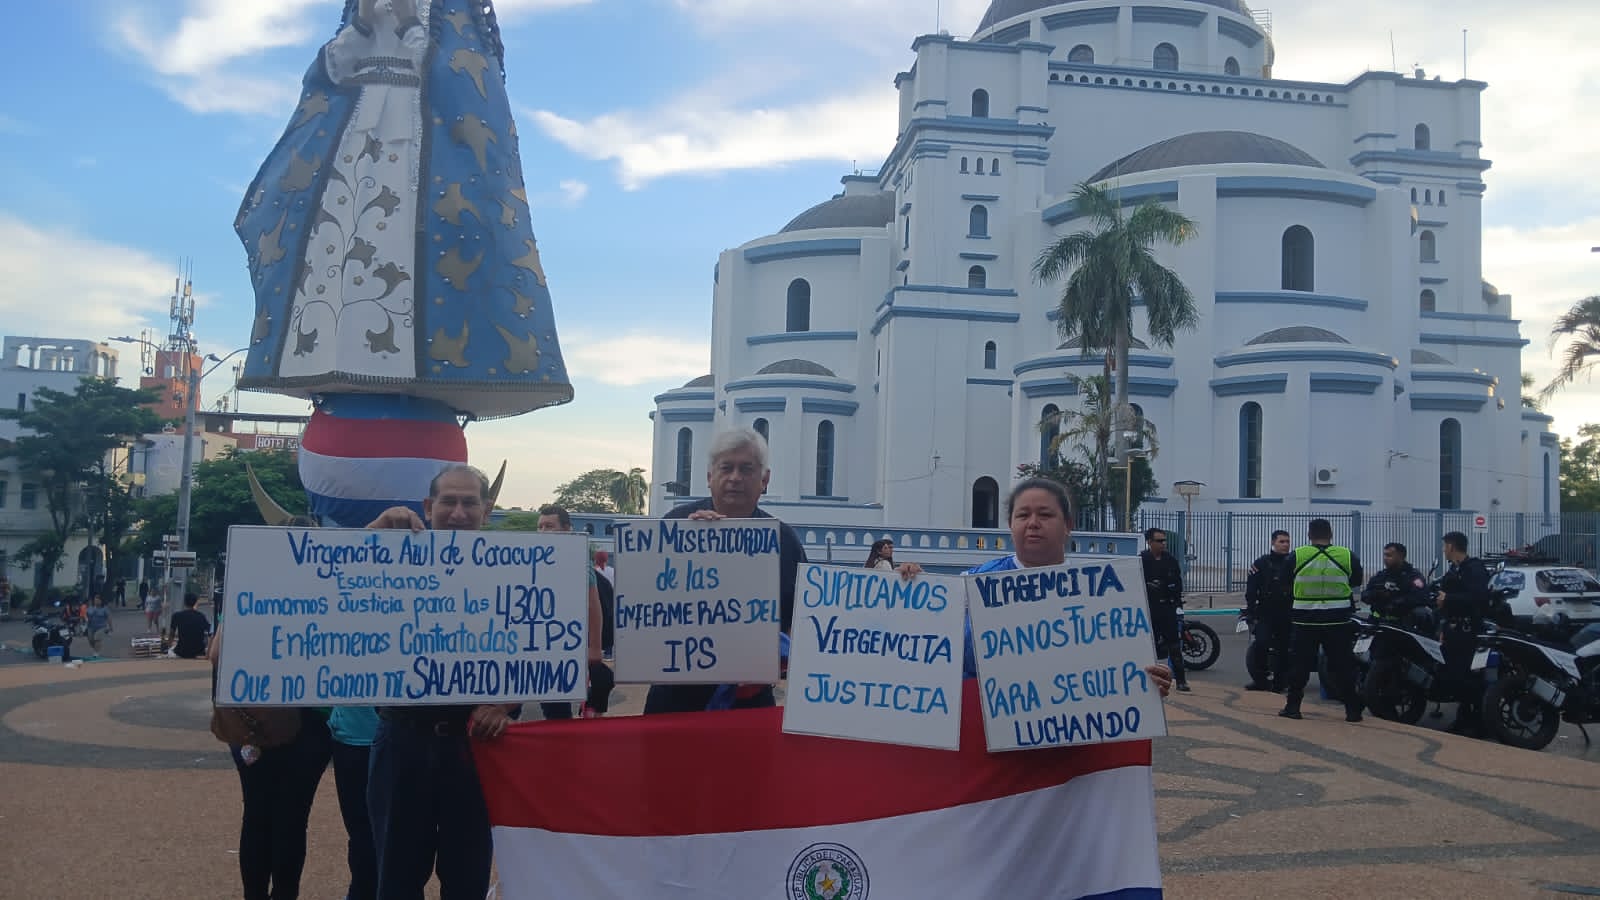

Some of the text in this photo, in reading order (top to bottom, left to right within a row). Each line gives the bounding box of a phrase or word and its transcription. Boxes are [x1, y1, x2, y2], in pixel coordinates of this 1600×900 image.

[287, 531, 393, 579] Virgencita
[398, 531, 435, 567] Azul
[439, 530, 464, 566] de
[613, 520, 781, 557] TEN MISERICORDIA
[656, 557, 720, 592] de las
[975, 563, 1125, 608] VIRGENCITA
[237, 591, 329, 617] Clamamos
[338, 592, 405, 615] Justicia
[413, 596, 457, 630] para
[463, 587, 490, 615] las
[744, 599, 781, 625] DEL
[271, 618, 582, 660] Enfermeras Contratadas IPS
[662, 636, 717, 673] IPS
[809, 615, 952, 664] VIRGENCITA
[980, 619, 1069, 659] DANOS
[281, 673, 306, 703] no
[317, 665, 379, 700] Ganan
[406, 655, 500, 700] SALARIO
[504, 658, 579, 696] MINIMO
[804, 673, 948, 715] JUSTICIA
[985, 661, 1148, 719] PARA SEGUIR
[1014, 706, 1141, 746] LUCHANDO
